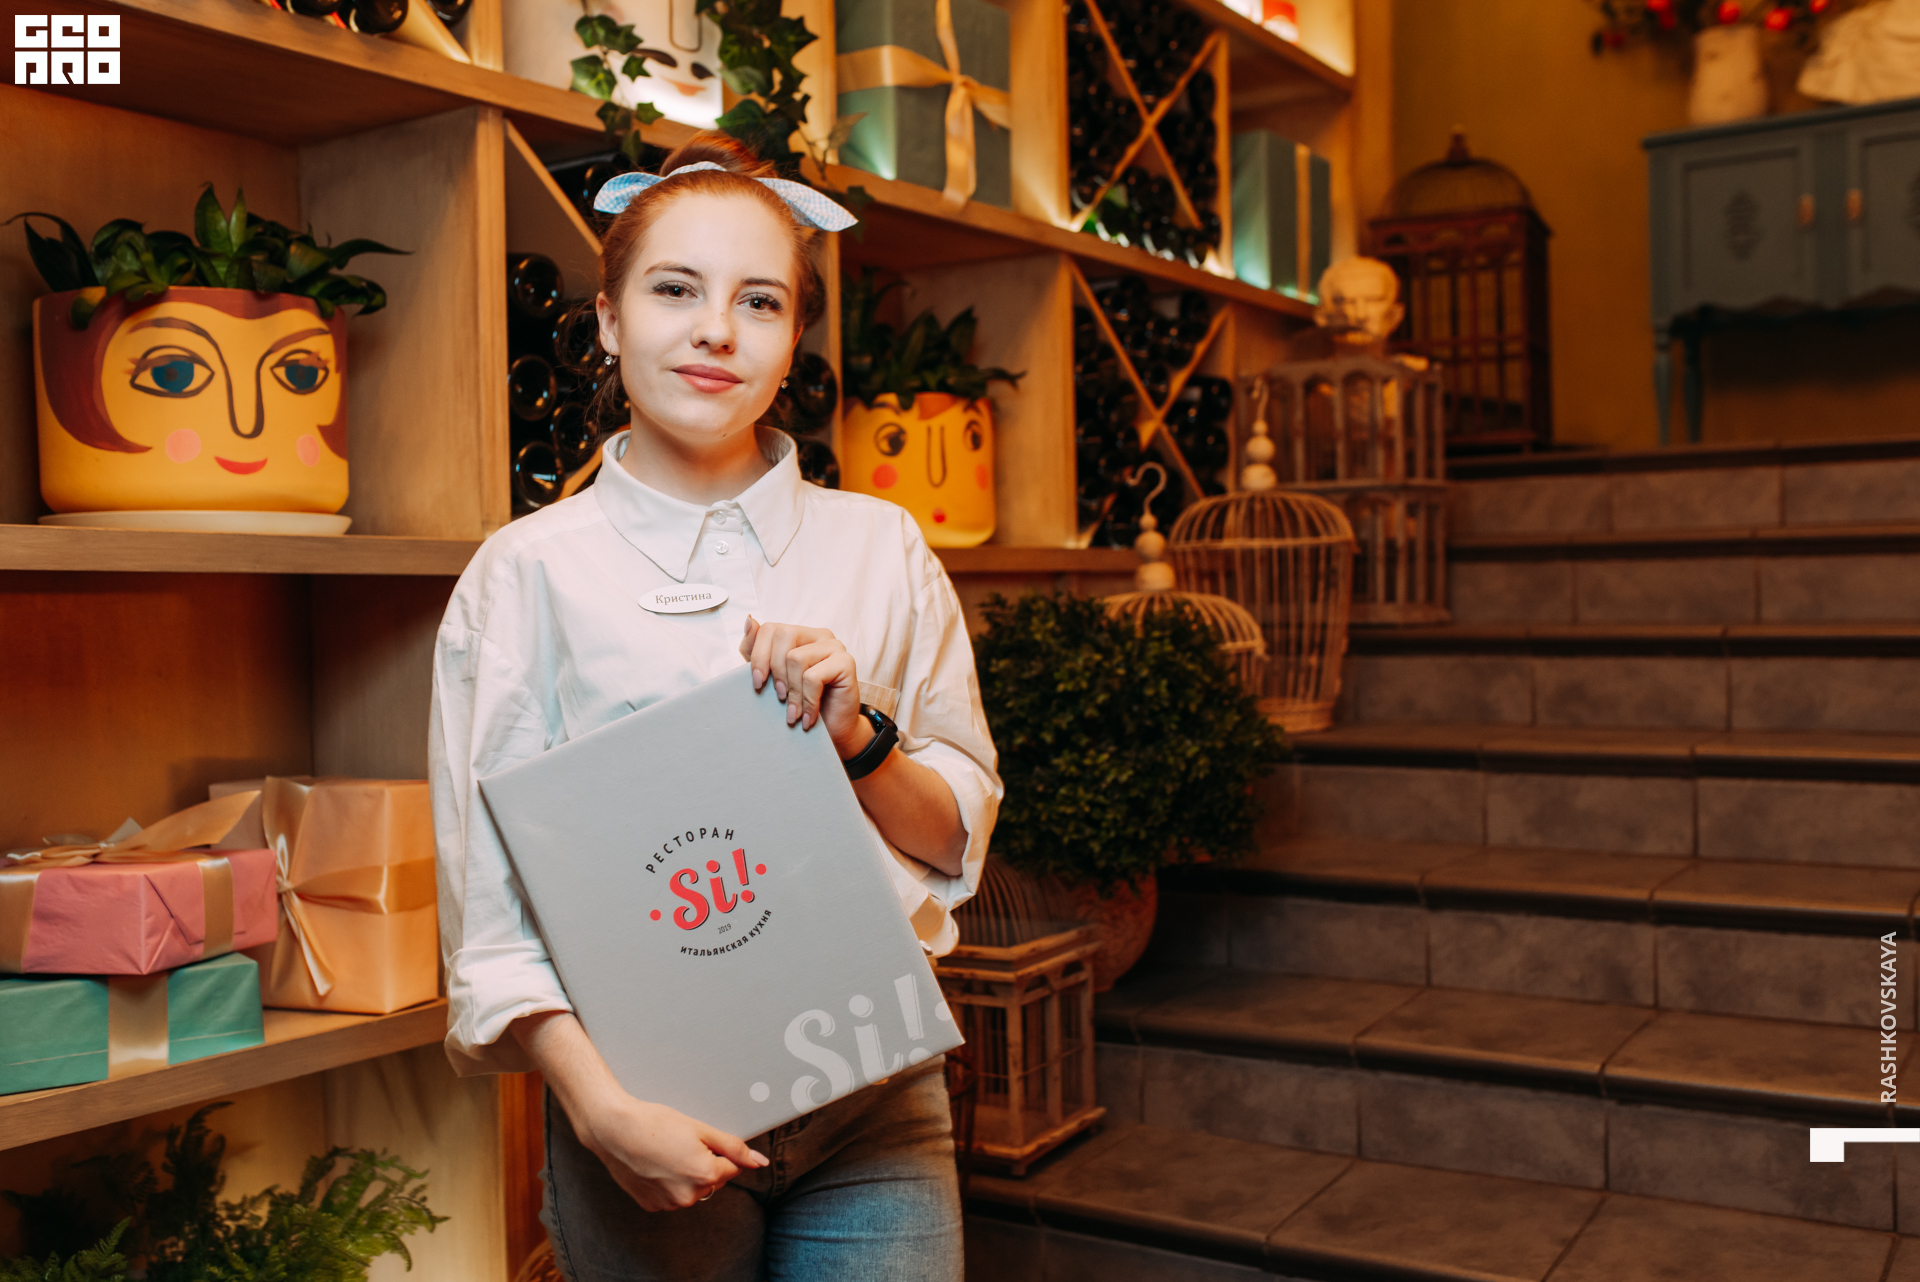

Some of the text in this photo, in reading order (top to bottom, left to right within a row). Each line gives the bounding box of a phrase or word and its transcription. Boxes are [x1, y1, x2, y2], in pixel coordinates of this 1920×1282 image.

[655, 592, 712, 605] Кристина
[645, 827, 734, 874] РЕСТОРАН
[669, 848, 755, 930] Si!
[680, 909, 772, 956] итальянская кухня
[717, 923, 732, 934] 2019
